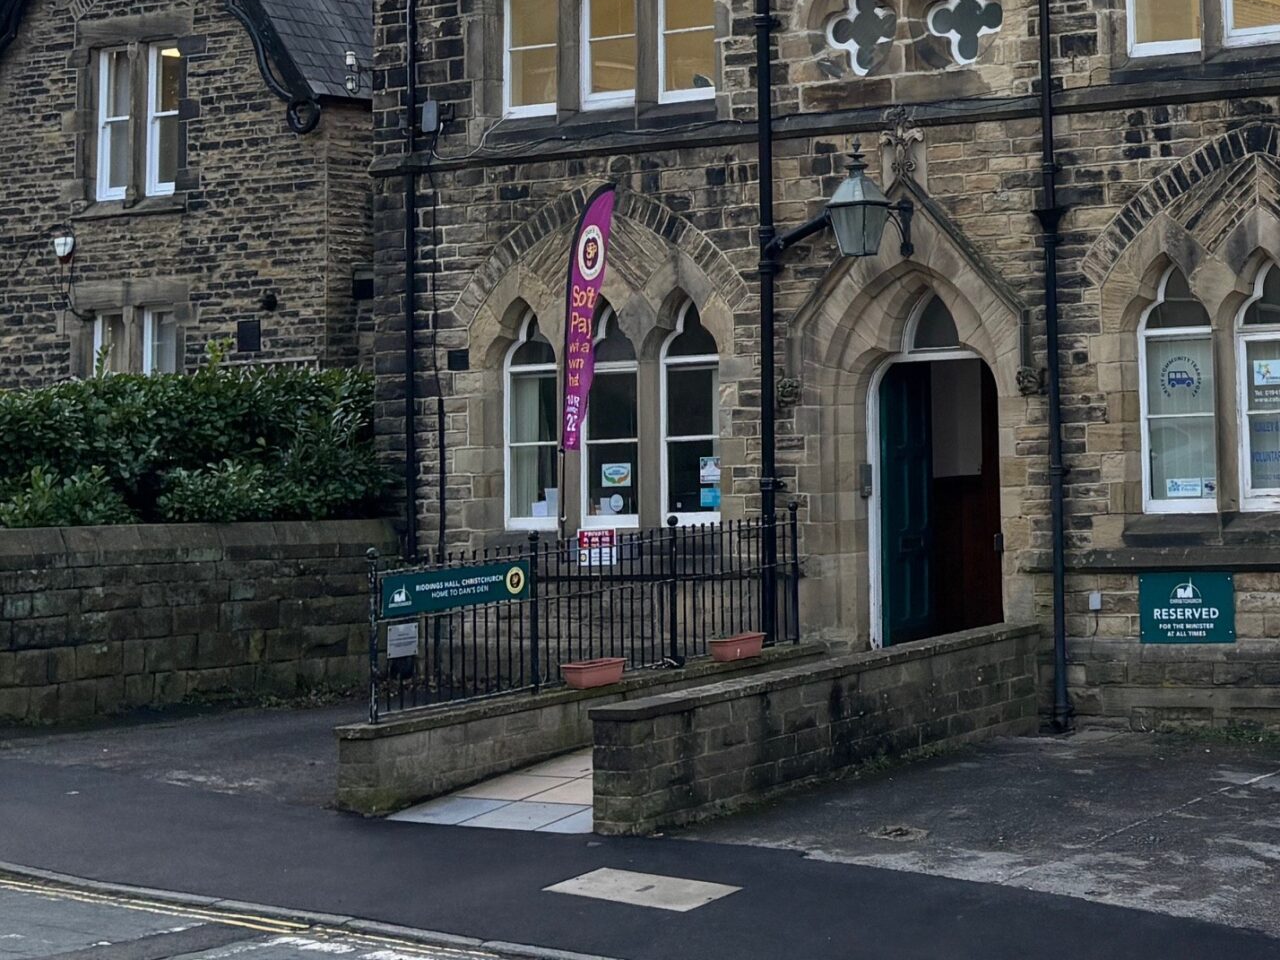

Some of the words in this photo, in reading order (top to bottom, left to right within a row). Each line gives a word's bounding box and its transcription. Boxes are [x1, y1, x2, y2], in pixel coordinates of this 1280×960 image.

[461, 575, 503, 585] CHRISTCHURCH
[432, 590, 449, 598] HOME
[459, 587, 475, 595] DAN'S
[1153, 608, 1219, 619] RESERVED
